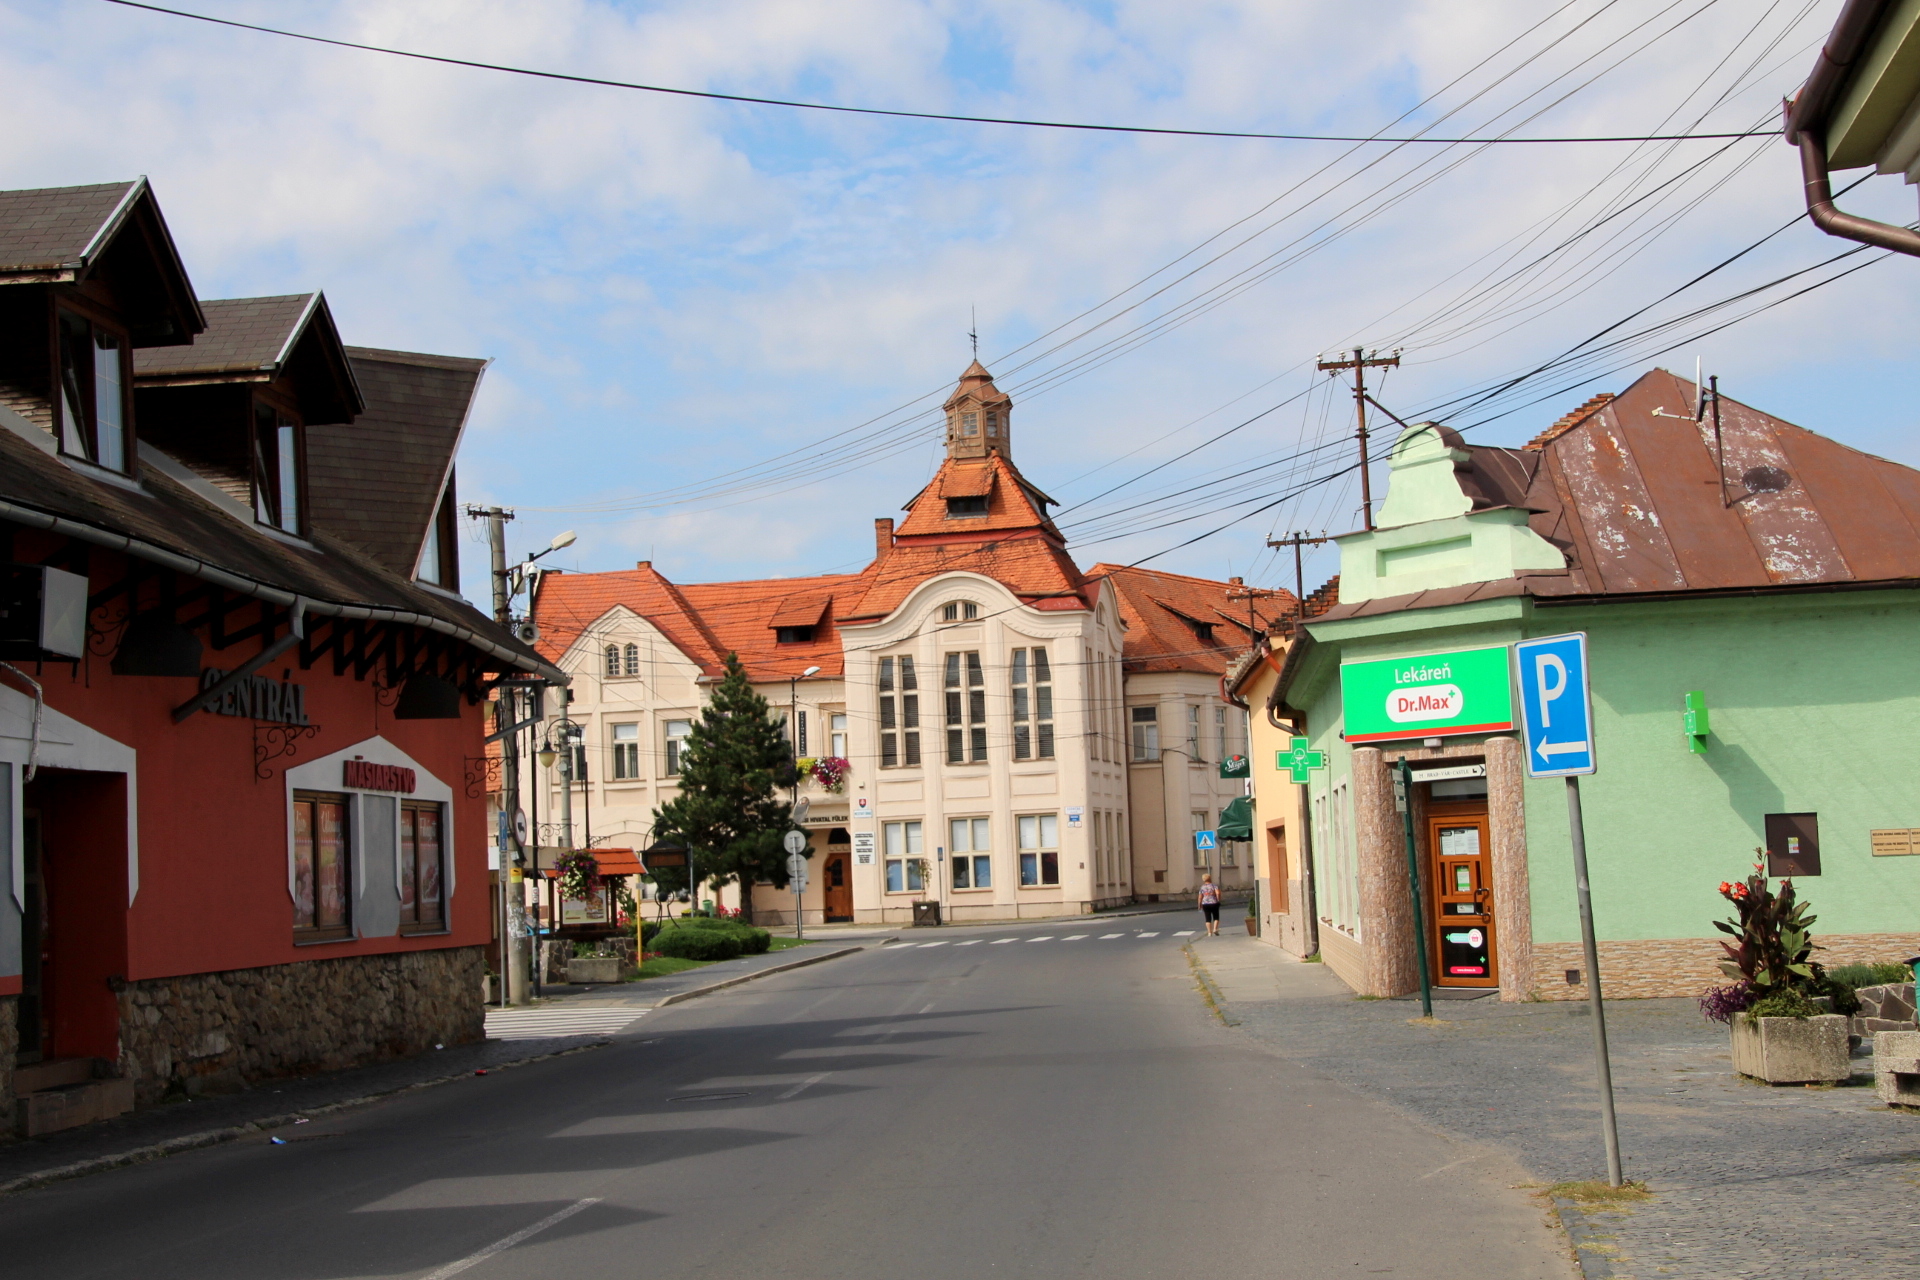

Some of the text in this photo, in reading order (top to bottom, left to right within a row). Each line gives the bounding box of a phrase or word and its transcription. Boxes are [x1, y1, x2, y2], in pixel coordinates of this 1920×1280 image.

[1394, 662, 1452, 684] Lekáreň
[1535, 653, 1567, 728] P
[202, 667, 309, 726] CENTRÁL
[1398, 695, 1449, 713] Dr.Max
[343, 755, 416, 793] MÄSIARSTVO
